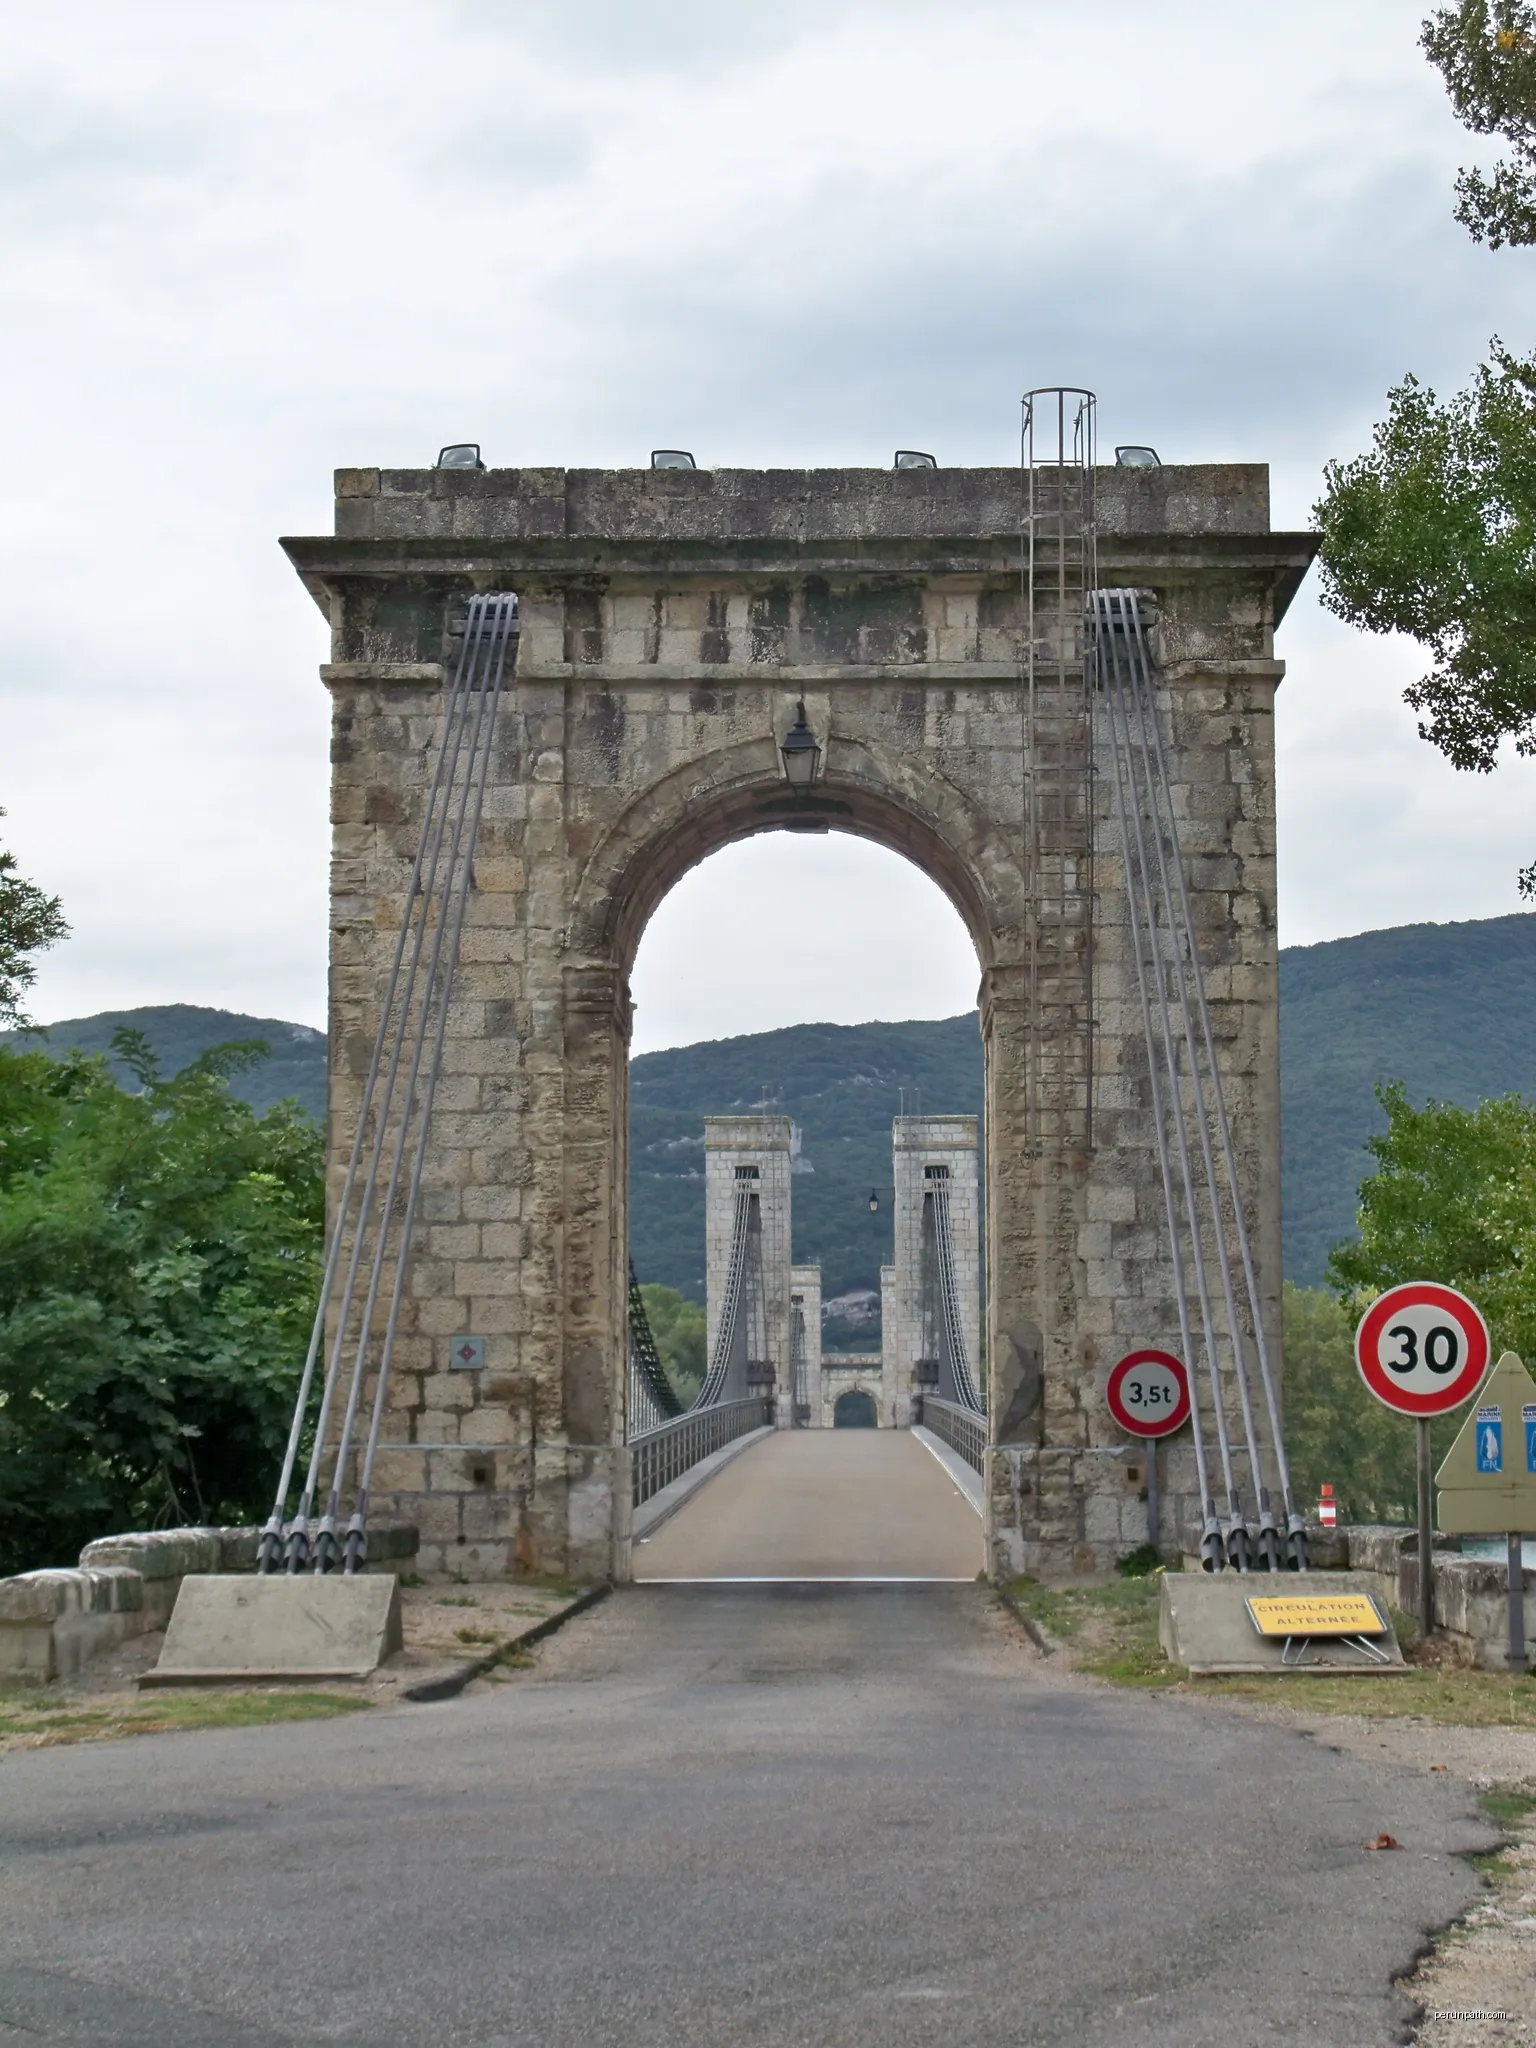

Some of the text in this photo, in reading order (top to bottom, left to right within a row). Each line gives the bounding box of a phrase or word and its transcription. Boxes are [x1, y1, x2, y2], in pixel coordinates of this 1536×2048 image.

[1388, 1325, 1458, 1374] 30
[1129, 1382, 1172, 1407] 3,5t
[1482, 1460, 1498, 1470] FN
[1258, 1603, 1366, 1612] CIRCULATION
[1277, 1616, 1360, 1625] ALTERNÉE
